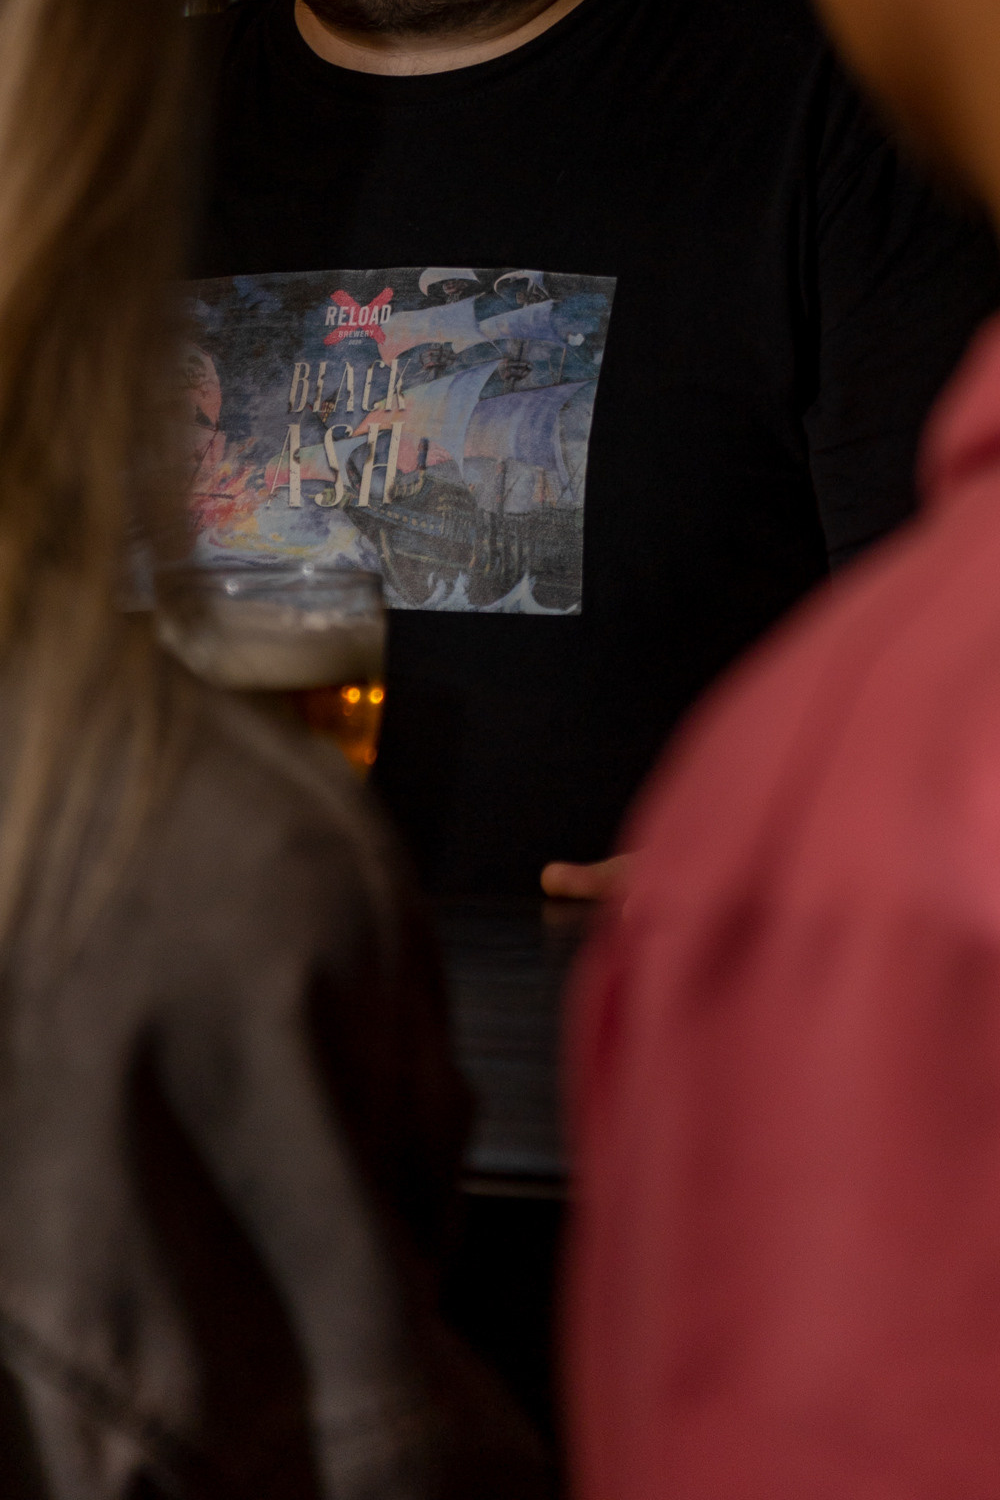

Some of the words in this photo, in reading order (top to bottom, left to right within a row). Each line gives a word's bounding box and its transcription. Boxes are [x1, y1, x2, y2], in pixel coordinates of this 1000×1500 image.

[324, 304, 392, 326] RELOAD
[338, 329, 374, 338] BREWERY
[289, 357, 411, 414] BLACK
[266, 421, 405, 508] ASH
